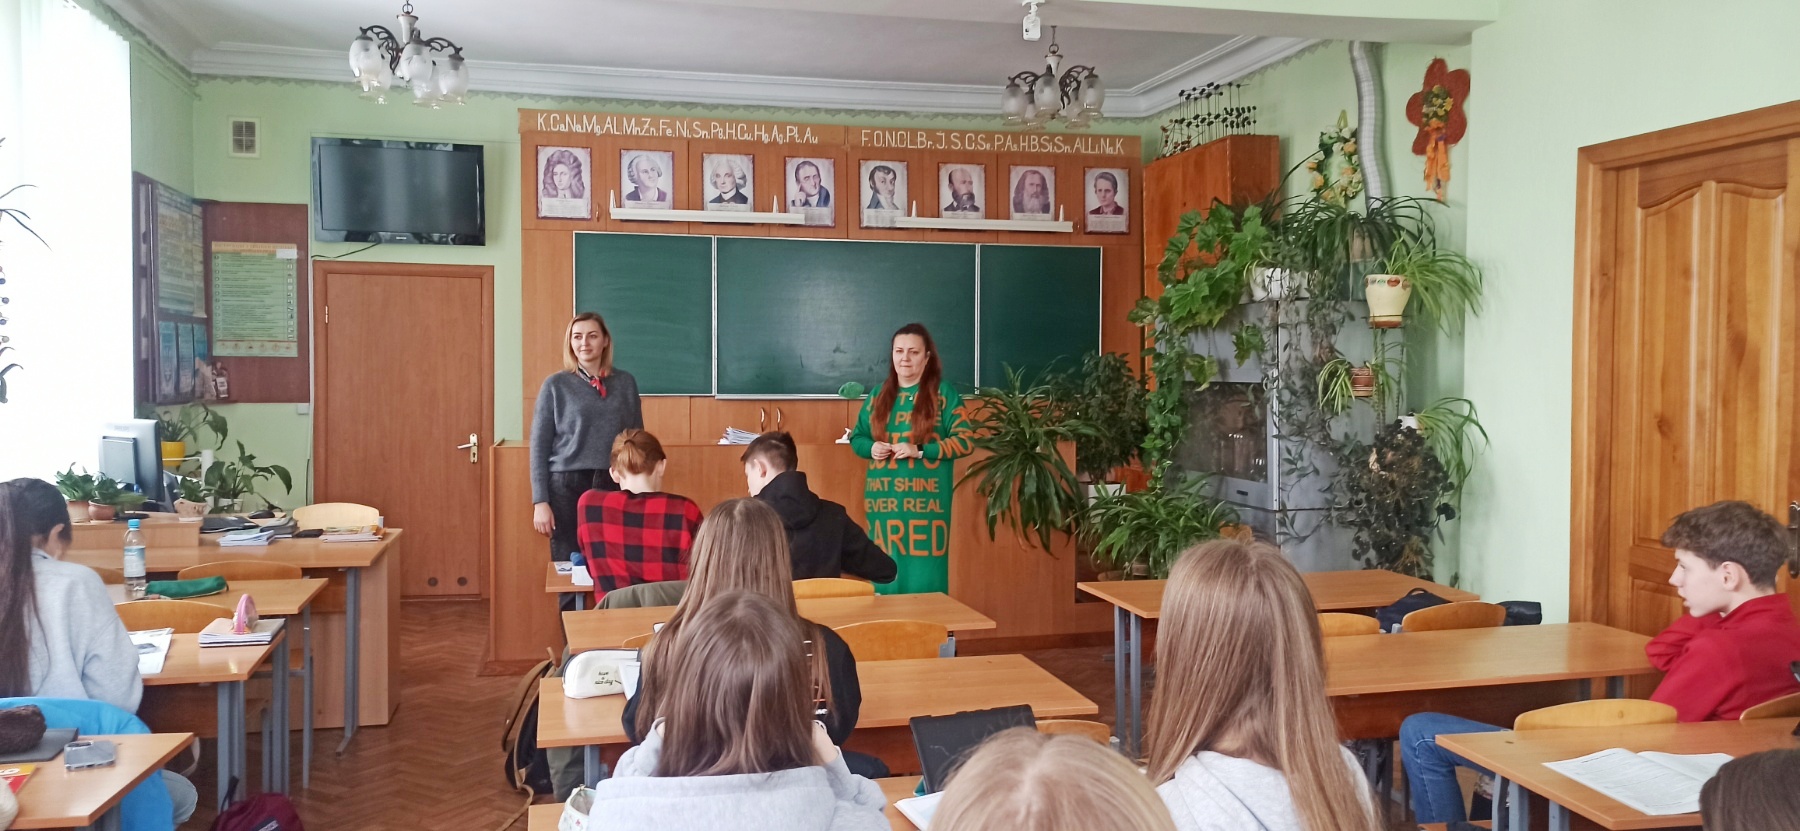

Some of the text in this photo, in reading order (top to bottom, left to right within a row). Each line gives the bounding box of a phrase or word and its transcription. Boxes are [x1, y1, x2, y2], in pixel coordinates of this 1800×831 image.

[866, 477, 940, 492] THAT SHINE
[903, 498, 944, 513] REAL
[868, 519, 948, 556] ARED
